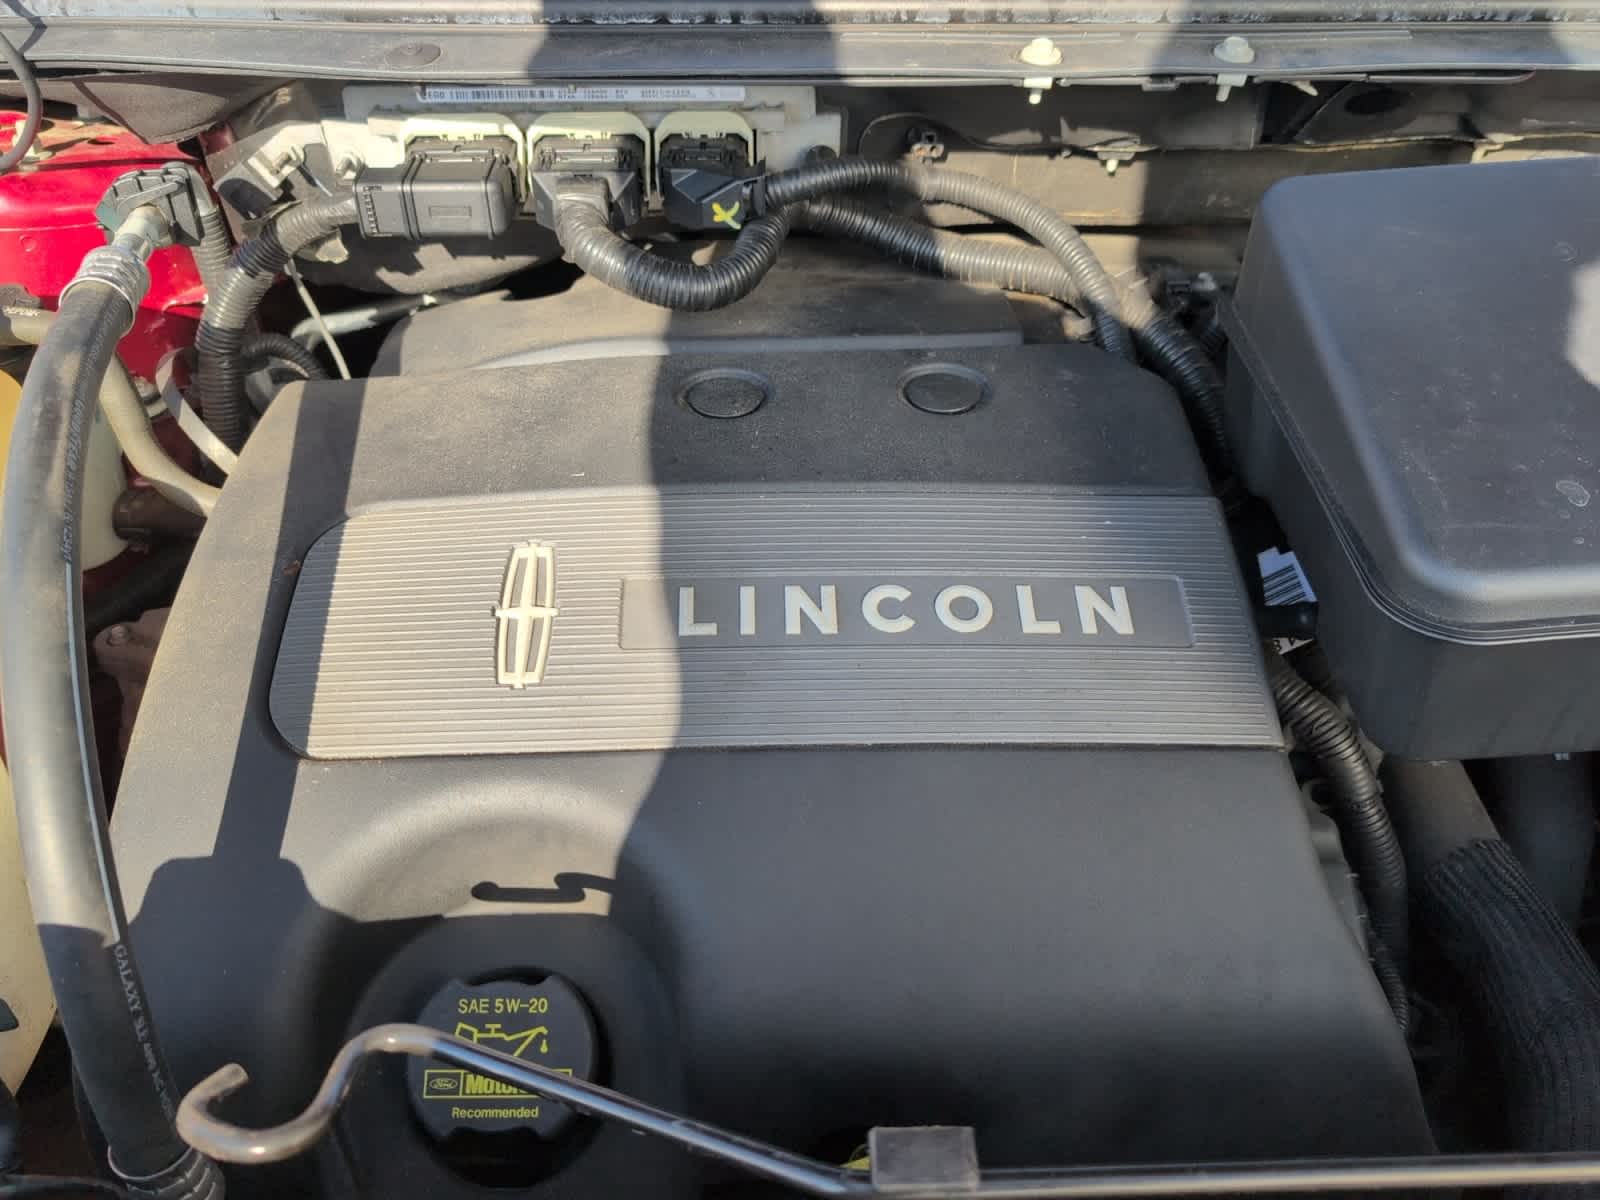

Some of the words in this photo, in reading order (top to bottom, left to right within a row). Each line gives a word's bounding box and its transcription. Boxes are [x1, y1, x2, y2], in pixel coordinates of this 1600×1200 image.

[678, 584, 1135, 637] LINCOLN
[114, 944, 143, 1012] GALAXY
[457, 998, 489, 1014] SAE
[495, 998, 548, 1014] 5W-20
[452, 1106, 539, 1119] Recommended
